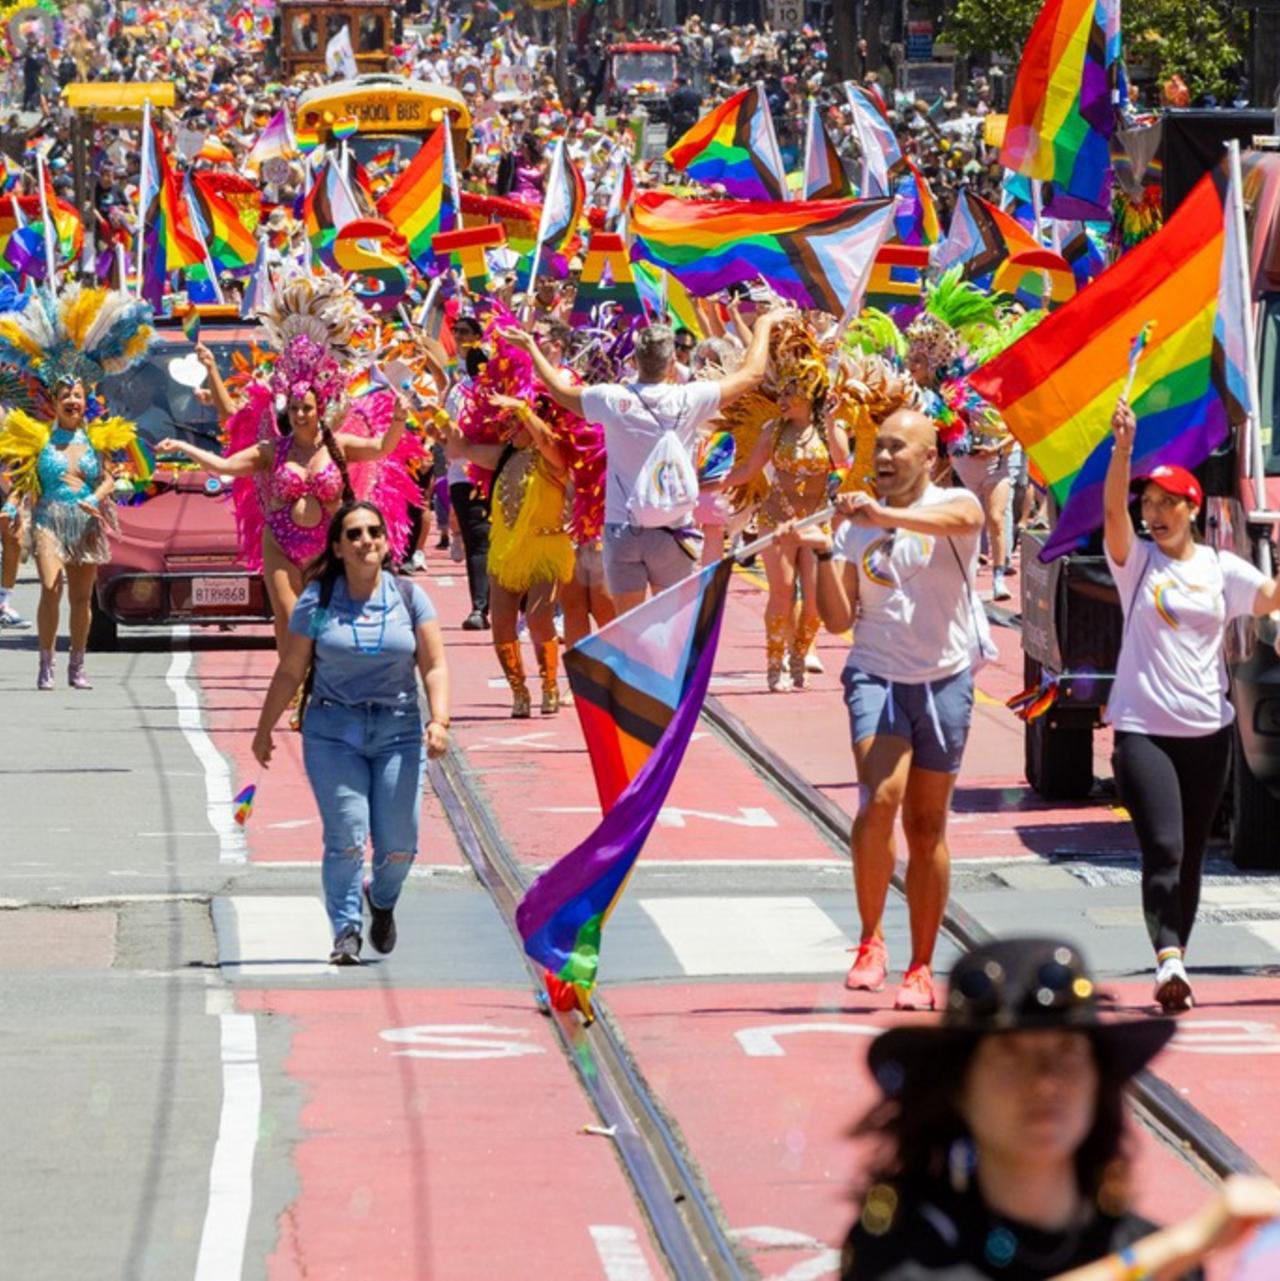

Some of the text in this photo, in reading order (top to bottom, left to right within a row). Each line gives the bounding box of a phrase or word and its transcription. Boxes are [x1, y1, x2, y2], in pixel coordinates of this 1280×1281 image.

[780, 8, 798, 21] 10
[345, 103, 420, 121] SCHOOL BUS
